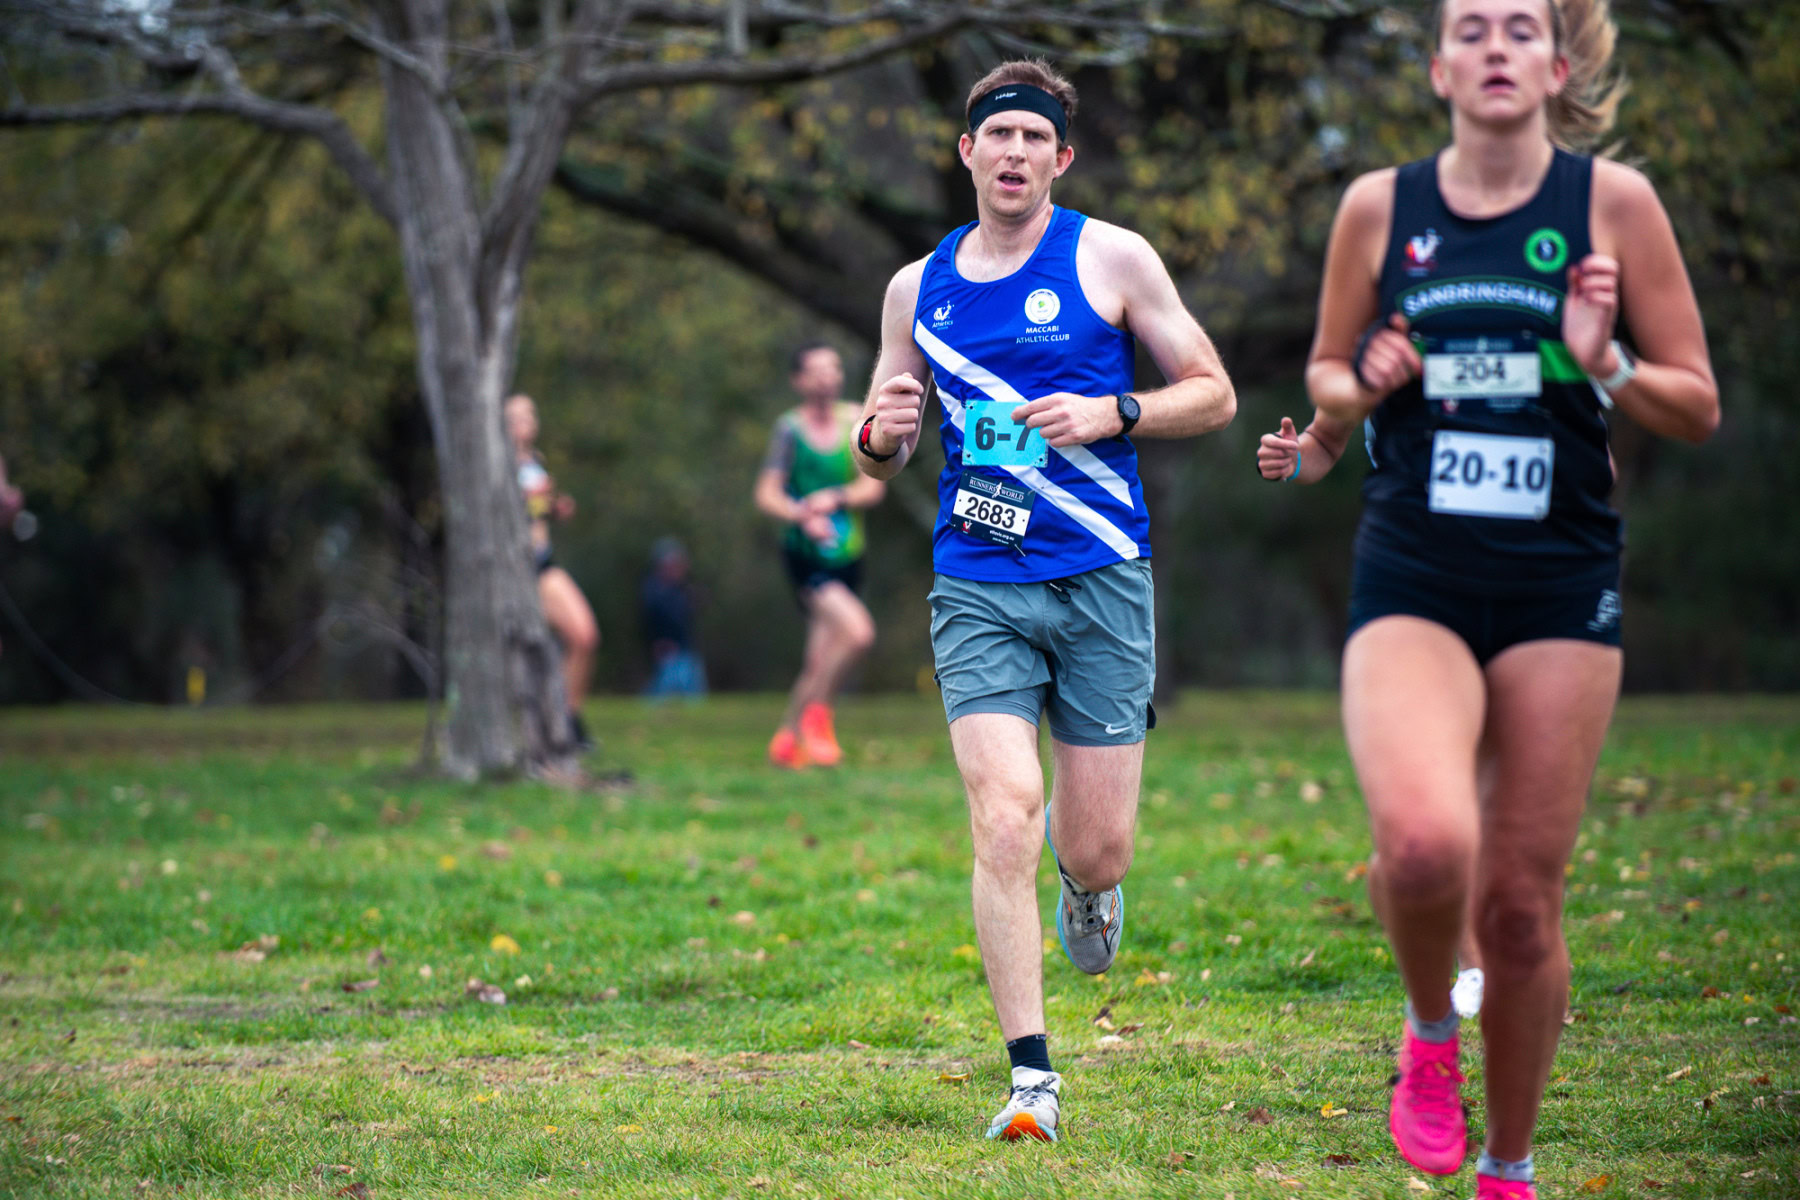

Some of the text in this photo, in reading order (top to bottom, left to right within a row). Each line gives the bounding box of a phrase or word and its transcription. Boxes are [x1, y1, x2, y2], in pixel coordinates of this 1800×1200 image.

[1403, 282, 1557, 316] SANDRINGHAM
[1016, 333, 1070, 344] ATHLETIC CLUB
[1025, 325, 1059, 334] MACCABI
[1454, 357, 1506, 381] 204
[975, 416, 1032, 451] 6-7
[1438, 449, 1546, 491] 20-10
[1001, 489, 1024, 501] WORLD
[965, 496, 1016, 529] 2683
